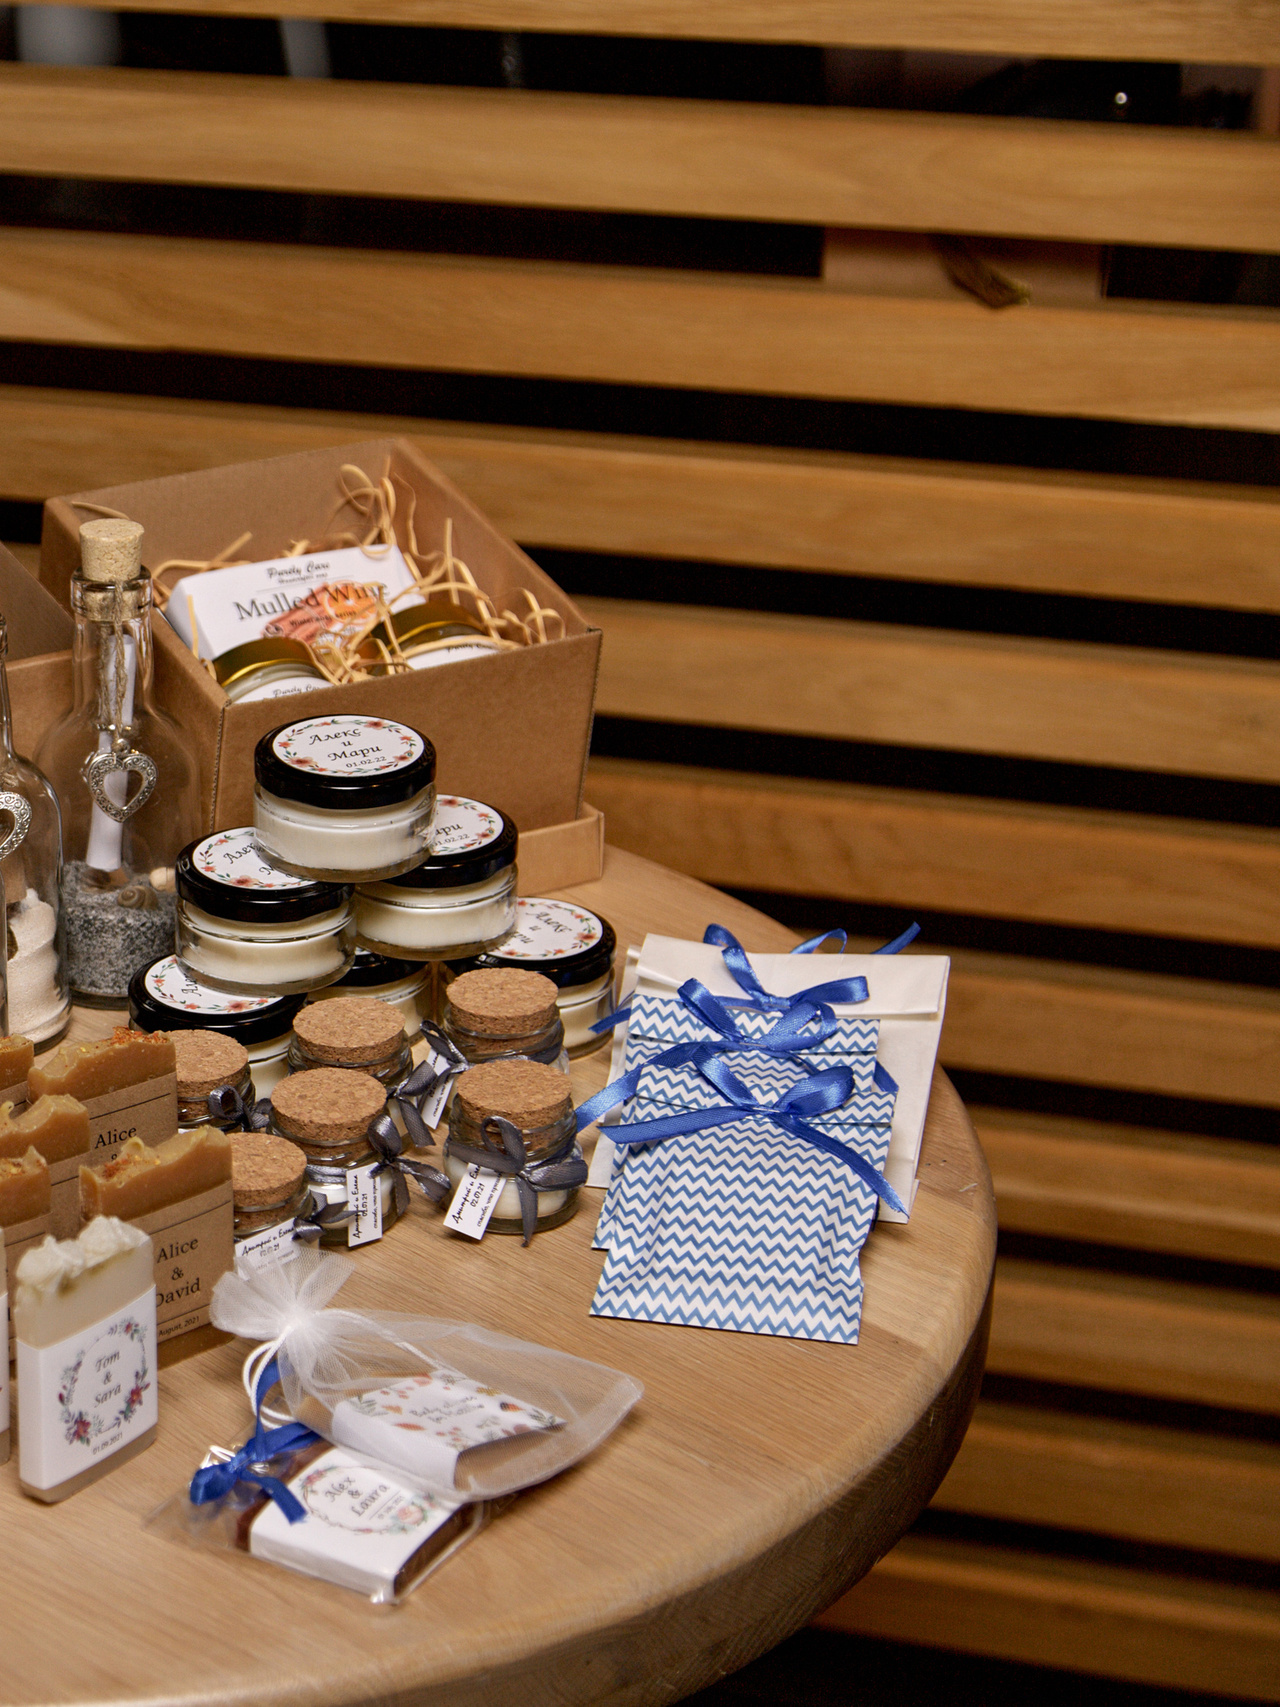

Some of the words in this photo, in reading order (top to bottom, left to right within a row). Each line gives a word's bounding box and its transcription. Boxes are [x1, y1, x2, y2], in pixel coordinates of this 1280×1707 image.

[233, 588, 321, 621] Mulled
[325, 582, 390, 604] Wine
[308, 727, 363, 746] Алекс
[327, 744, 383, 762] Мари
[345, 755, 387, 769] 01.02.22
[94, 1126, 137, 1149] Alice
[351, 1174, 359, 1196] Елена
[469, 1182, 486, 1208] 02.07.21
[451, 1186, 471, 1224] Дмитрий
[476, 1205, 490, 1228] спасибо,
[156, 1238, 199, 1264] Alice
[241, 1236, 272, 1257] Дмитрий
[170, 1266, 184, 1281] &
[183, 1315, 200, 1327] 2021
[94, 1350, 121, 1373] Tom
[103, 1371, 113, 1386] &
[94, 1384, 122, 1408] Sara
[92, 1432, 123, 1455] 01.09.2021
[324, 1476, 356, 1503] Alex
[347, 1488, 363, 1499] &
[351, 1484, 391, 1517] Laura
